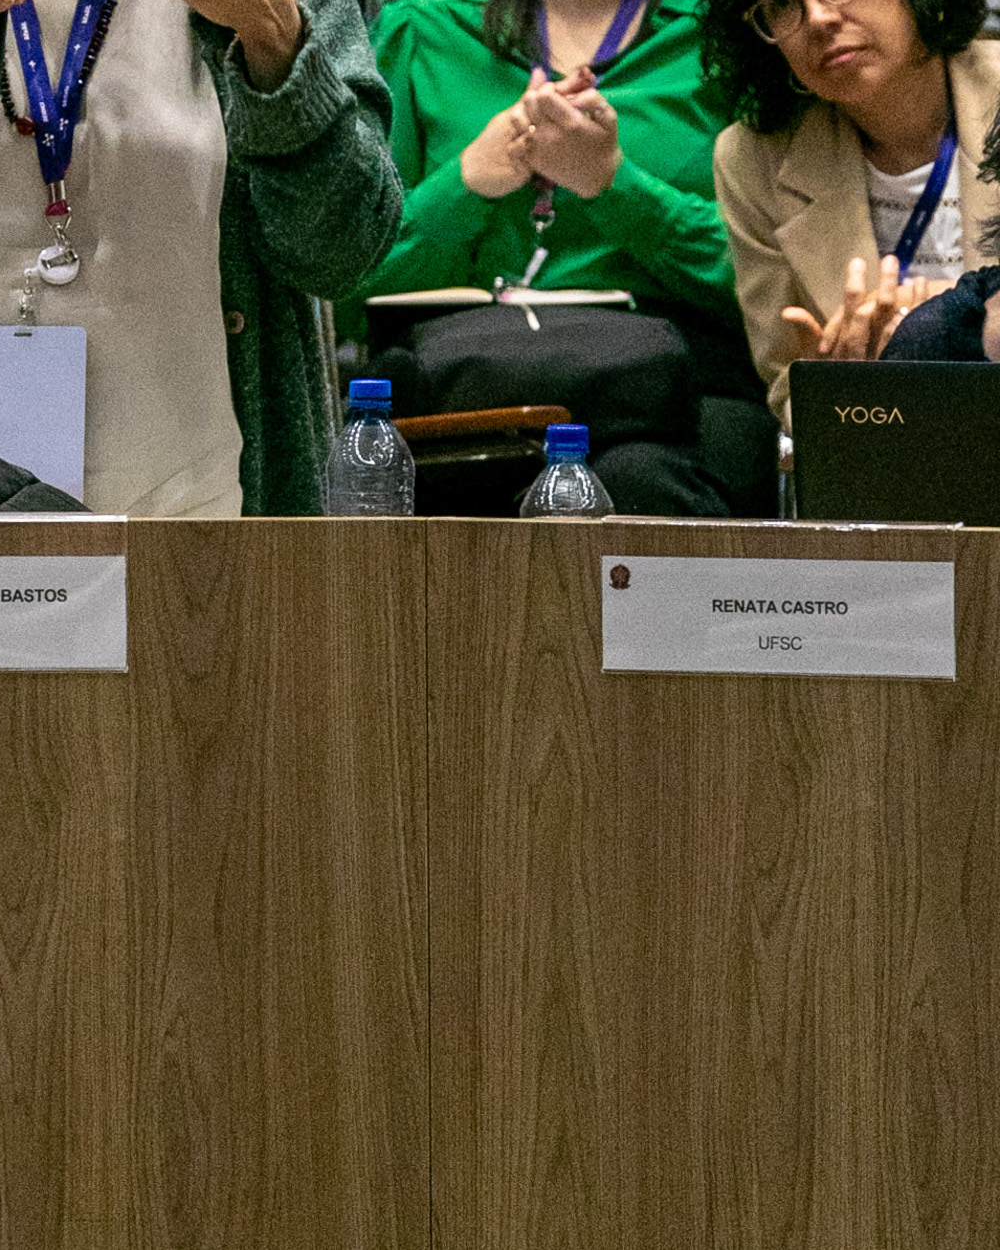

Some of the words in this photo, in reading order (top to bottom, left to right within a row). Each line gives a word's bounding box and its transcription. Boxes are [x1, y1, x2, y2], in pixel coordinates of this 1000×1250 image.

[834, 405, 905, 425] YOGA
[0, 588, 68, 603] BASTOS
[711, 598, 778, 614] RENATA
[781, 600, 849, 615] CASTRO
[758, 635, 803, 651] UFSC
